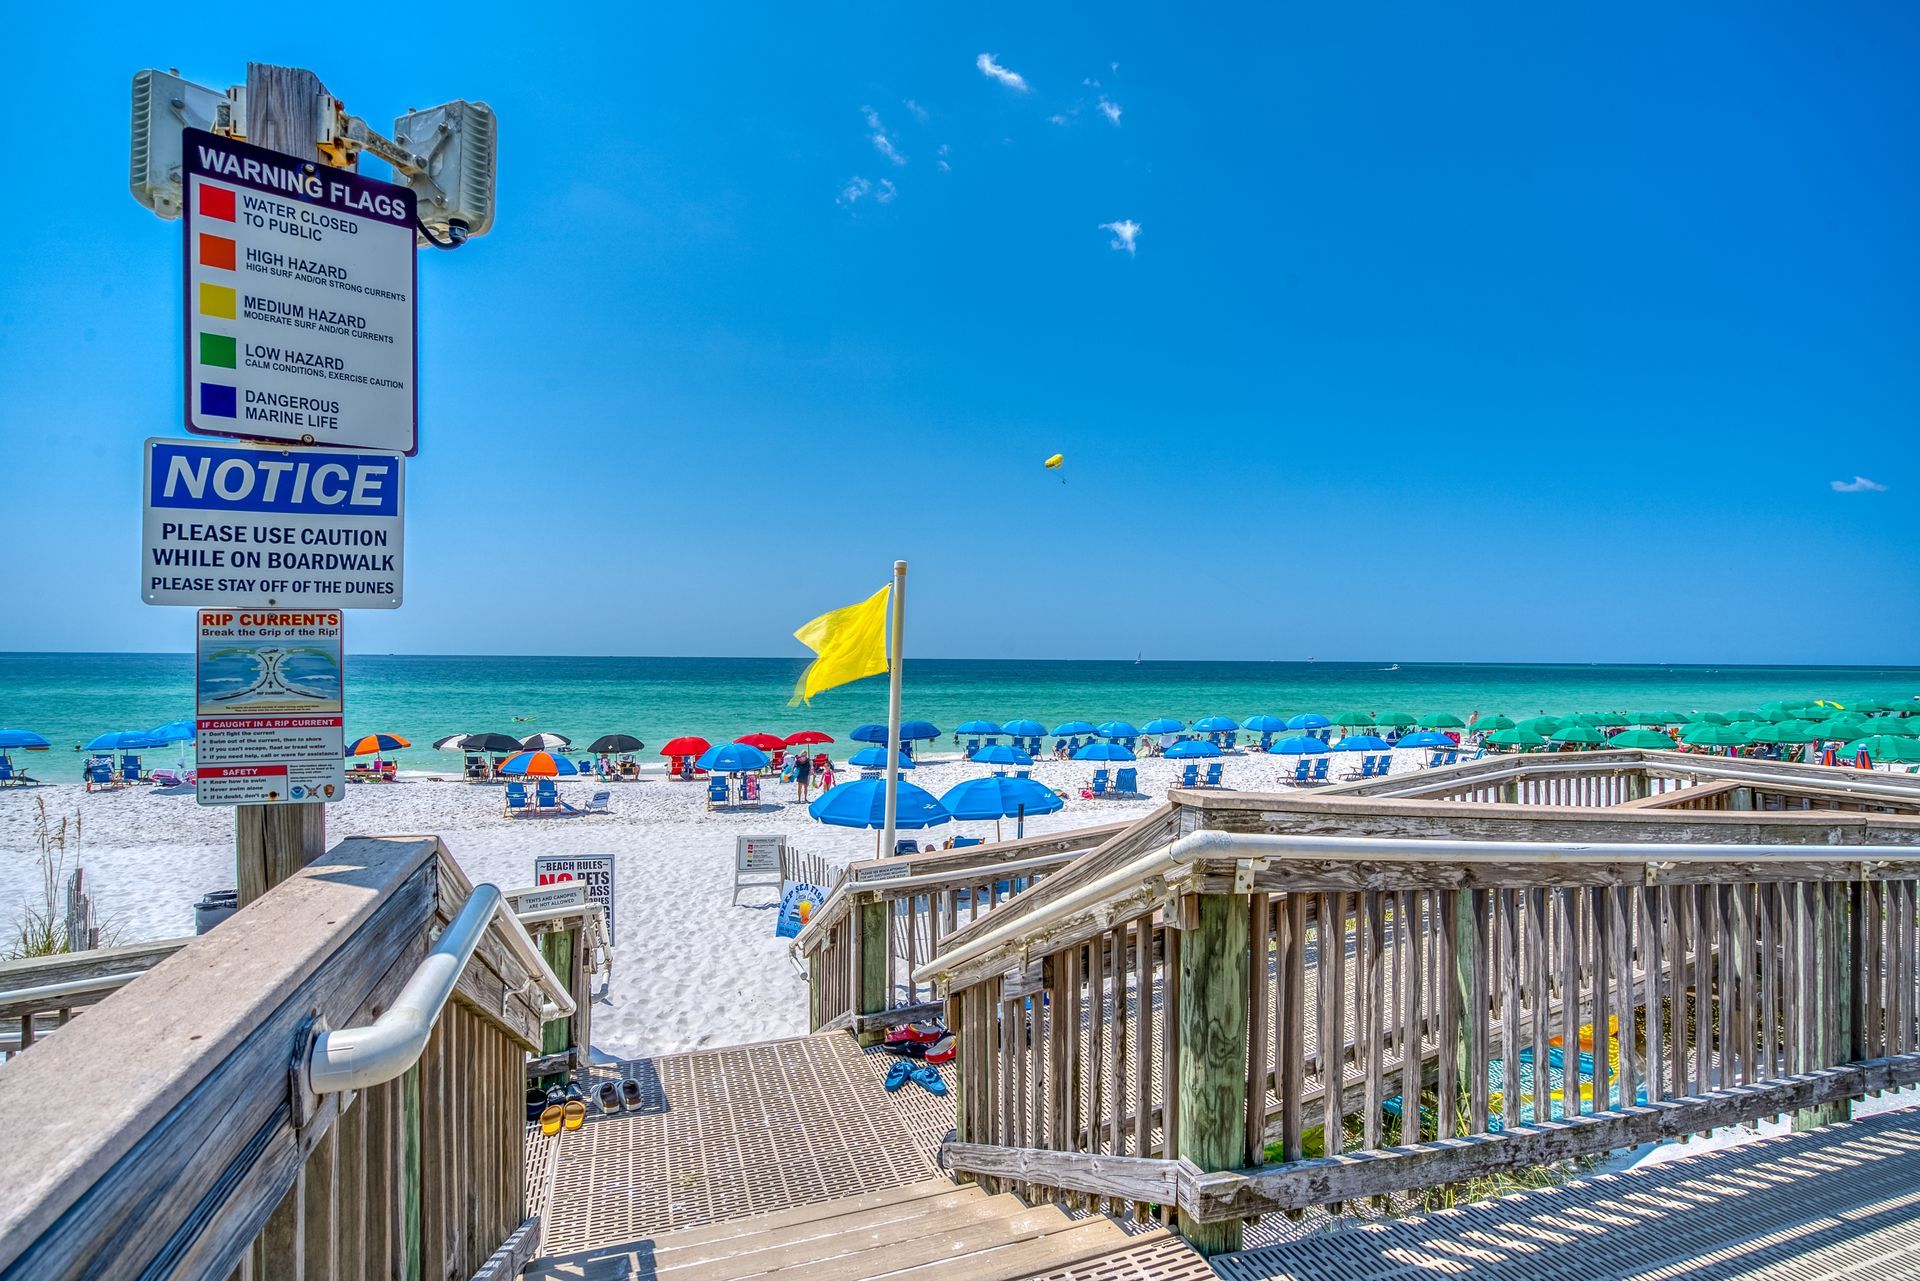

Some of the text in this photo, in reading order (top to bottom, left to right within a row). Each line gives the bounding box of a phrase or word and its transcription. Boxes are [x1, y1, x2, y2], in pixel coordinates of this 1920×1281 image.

[198, 145, 406, 220] WARNING FLAGS
[243, 195, 358, 234] WATER CLOSED
[243, 212, 322, 241] TO PUBLIC
[247, 248, 347, 280] HIGH HAZARD
[246, 262, 406, 302] HIGH SURF AND/OR STRONG CURRENTS
[244, 295, 366, 329] MEDIUM HAZARD
[244, 310, 394, 344] MODERATE SURF AND/OR CURRENTS
[246, 344, 344, 370] LOW HAZARD
[245, 359, 403, 389] CALM CONDITIONS, EXERCISE CAUTION
[246, 390, 339, 414] DANGEROUS
[246, 406, 338, 429] MARINE LIFE
[163, 456, 388, 506] NOTICE
[162, 523, 387, 546] PLEASE USE CAUTION
[152, 548, 394, 571] WHILE ON BOARDWALK
[152, 577, 394, 594] PLEASE STAY OFF OF THE DUNES
[203, 613, 338, 626] RIP CURRENTS
[259, 629, 281, 637] Grip
[319, 628, 338, 637] Rip!
[578, 872, 609, 885] PETS
[590, 886, 609, 896] ASS
[554, 892, 577, 900] CANOPIES
[780, 890, 793, 917] DEEP
[795, 884, 808, 893] SEA
